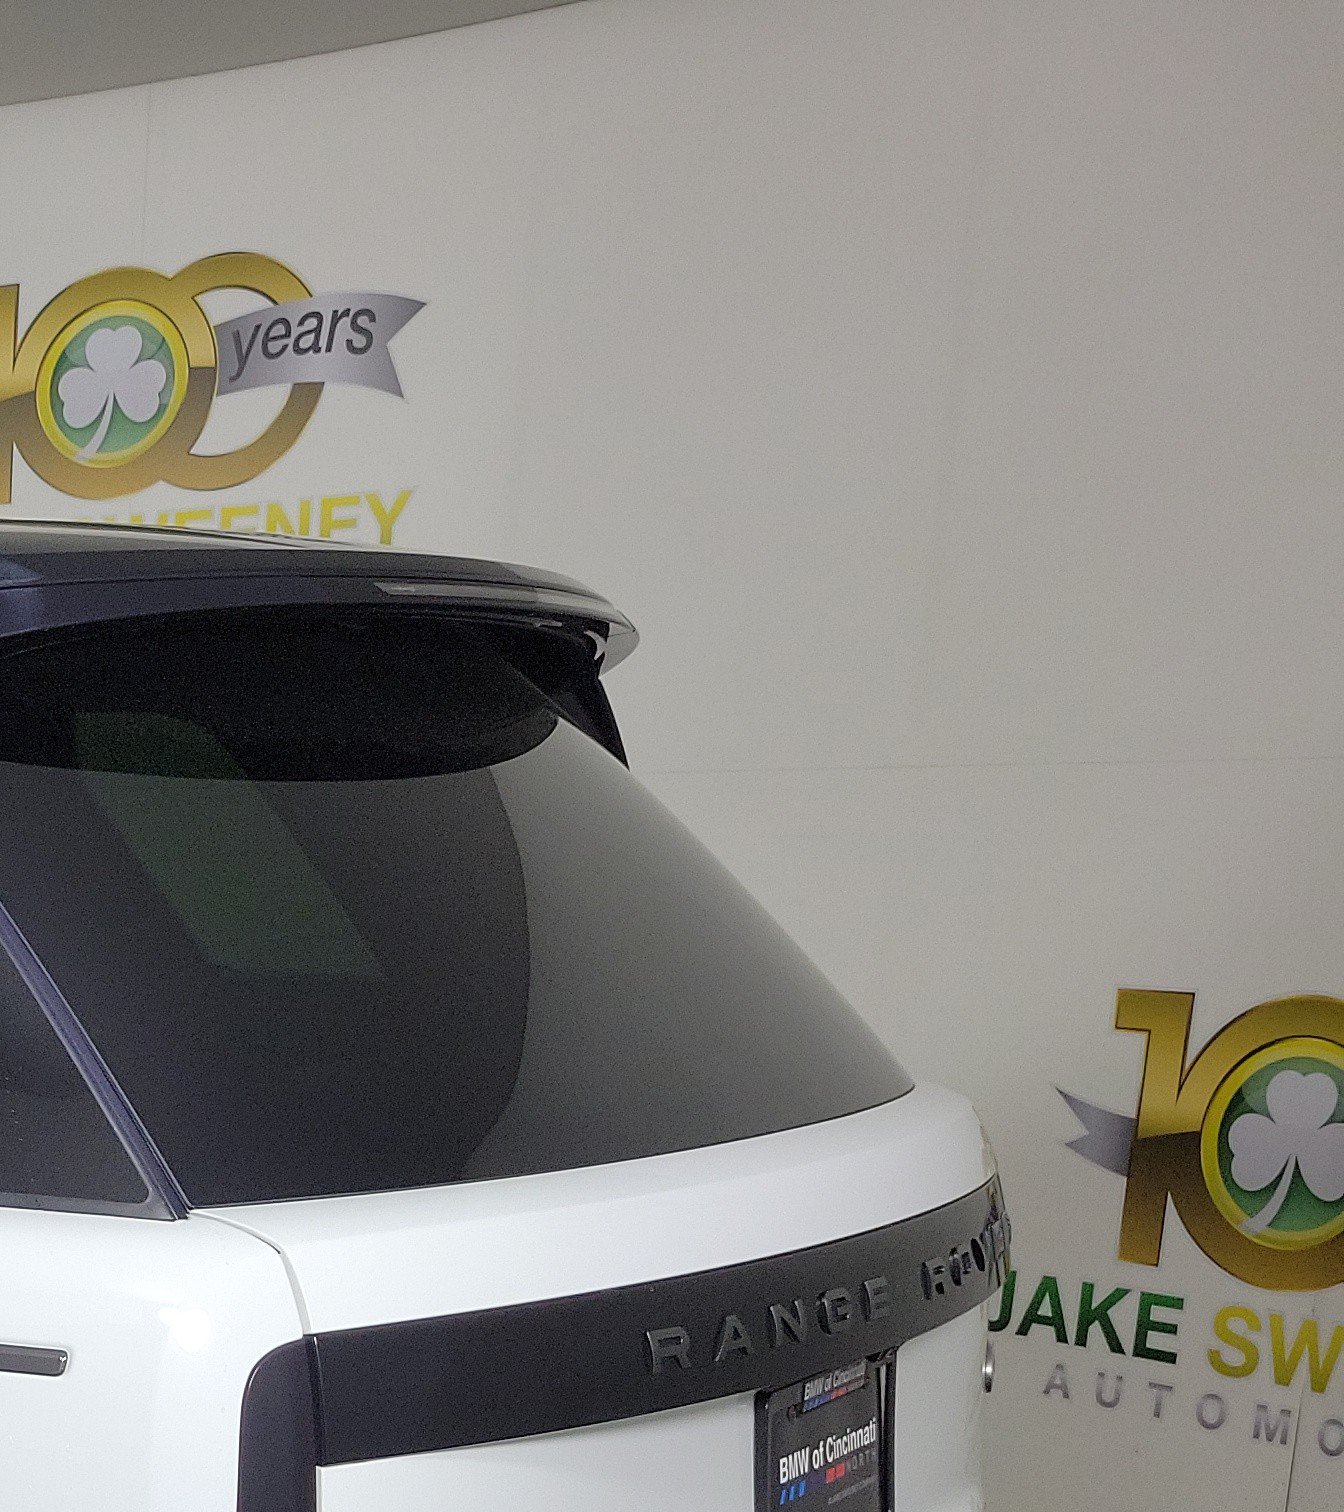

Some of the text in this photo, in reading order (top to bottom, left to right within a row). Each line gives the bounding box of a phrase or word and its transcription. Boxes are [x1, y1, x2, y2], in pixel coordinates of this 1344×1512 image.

[229, 305, 378, 384] years
[77, 490, 413, 545] ENEY
[646, 1276, 892, 1374] RANGE
[988, 1271, 1185, 1365] JAKE
[779, 1416, 876, 1485] BMW of Cincinnati
[1042, 1362, 1344, 1458] AUTOMO
